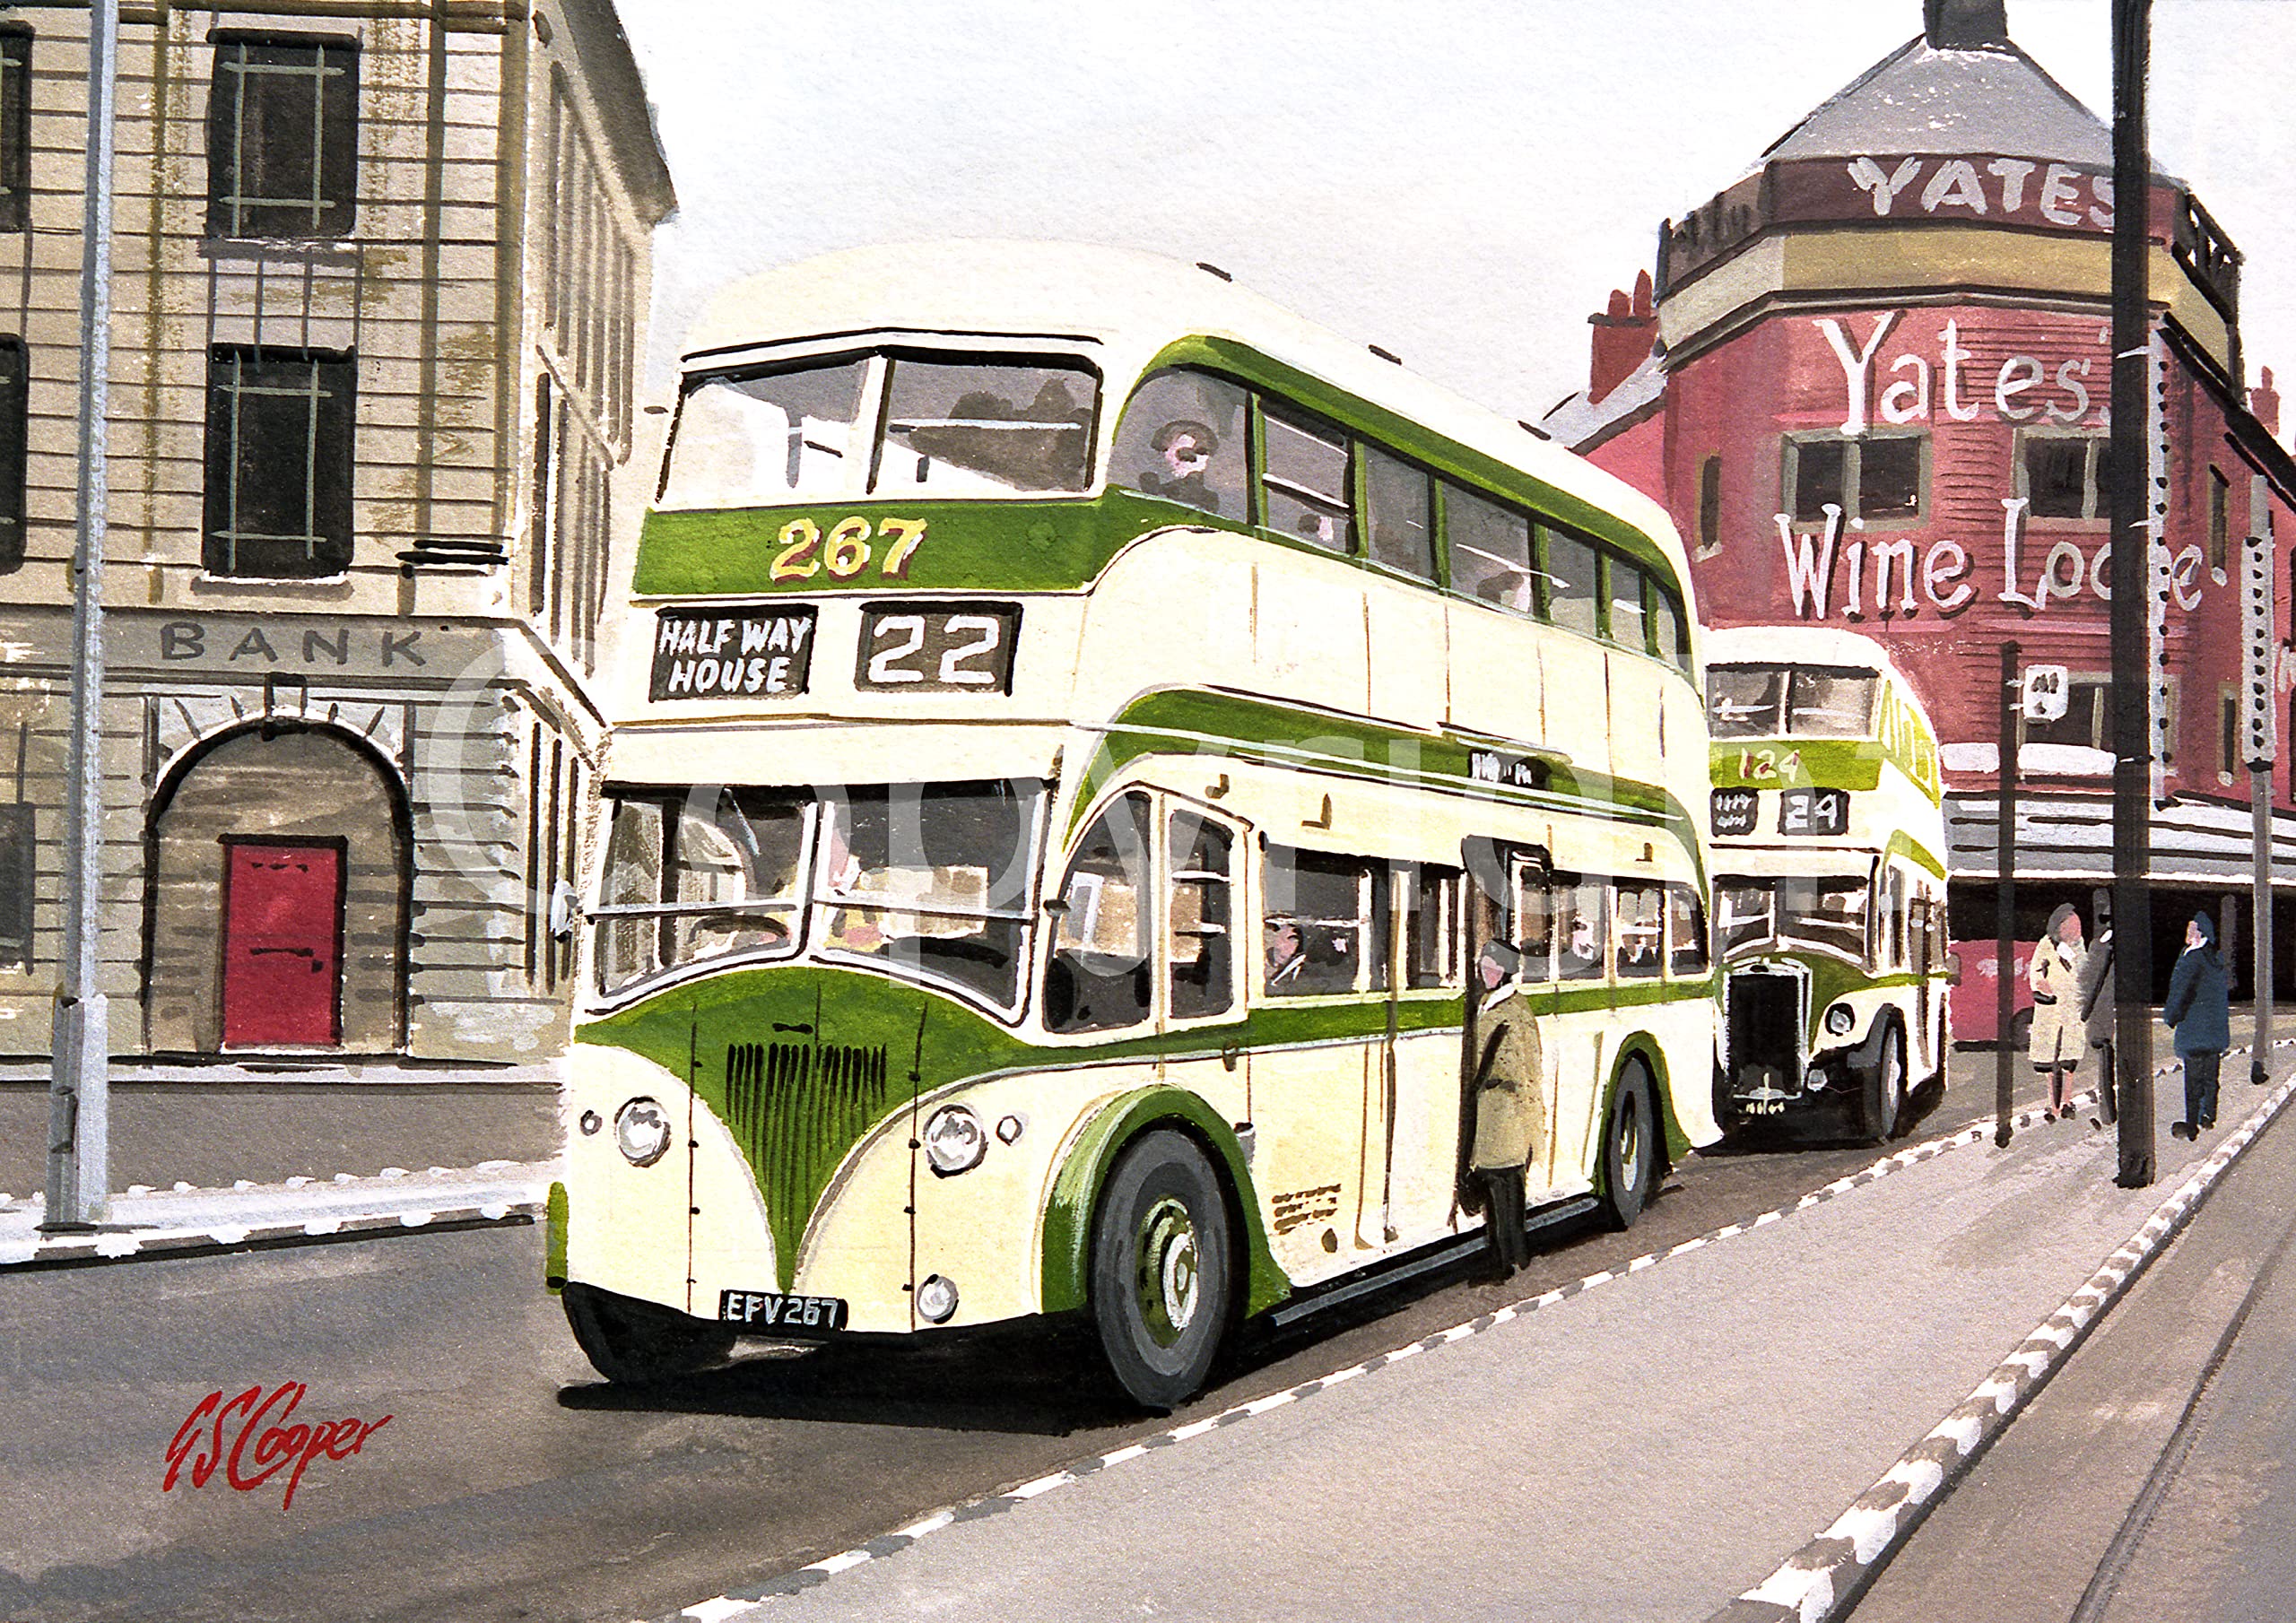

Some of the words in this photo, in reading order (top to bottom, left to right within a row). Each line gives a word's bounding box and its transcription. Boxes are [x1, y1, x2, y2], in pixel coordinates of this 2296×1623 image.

[770, 516, 927, 583] 267
[1772, 503, 1972, 620] Wine
[1997, 497, 2203, 611] Loe
[160, 621, 426, 668] BANK
[658, 619, 735, 656] HALF
[741, 616, 813, 655] WAY
[868, 615, 1000, 683] 22
[668, 656, 792, 693] HOUSE
[1738, 747, 1800, 783] 124
[1785, 794, 1837, 829] 24
